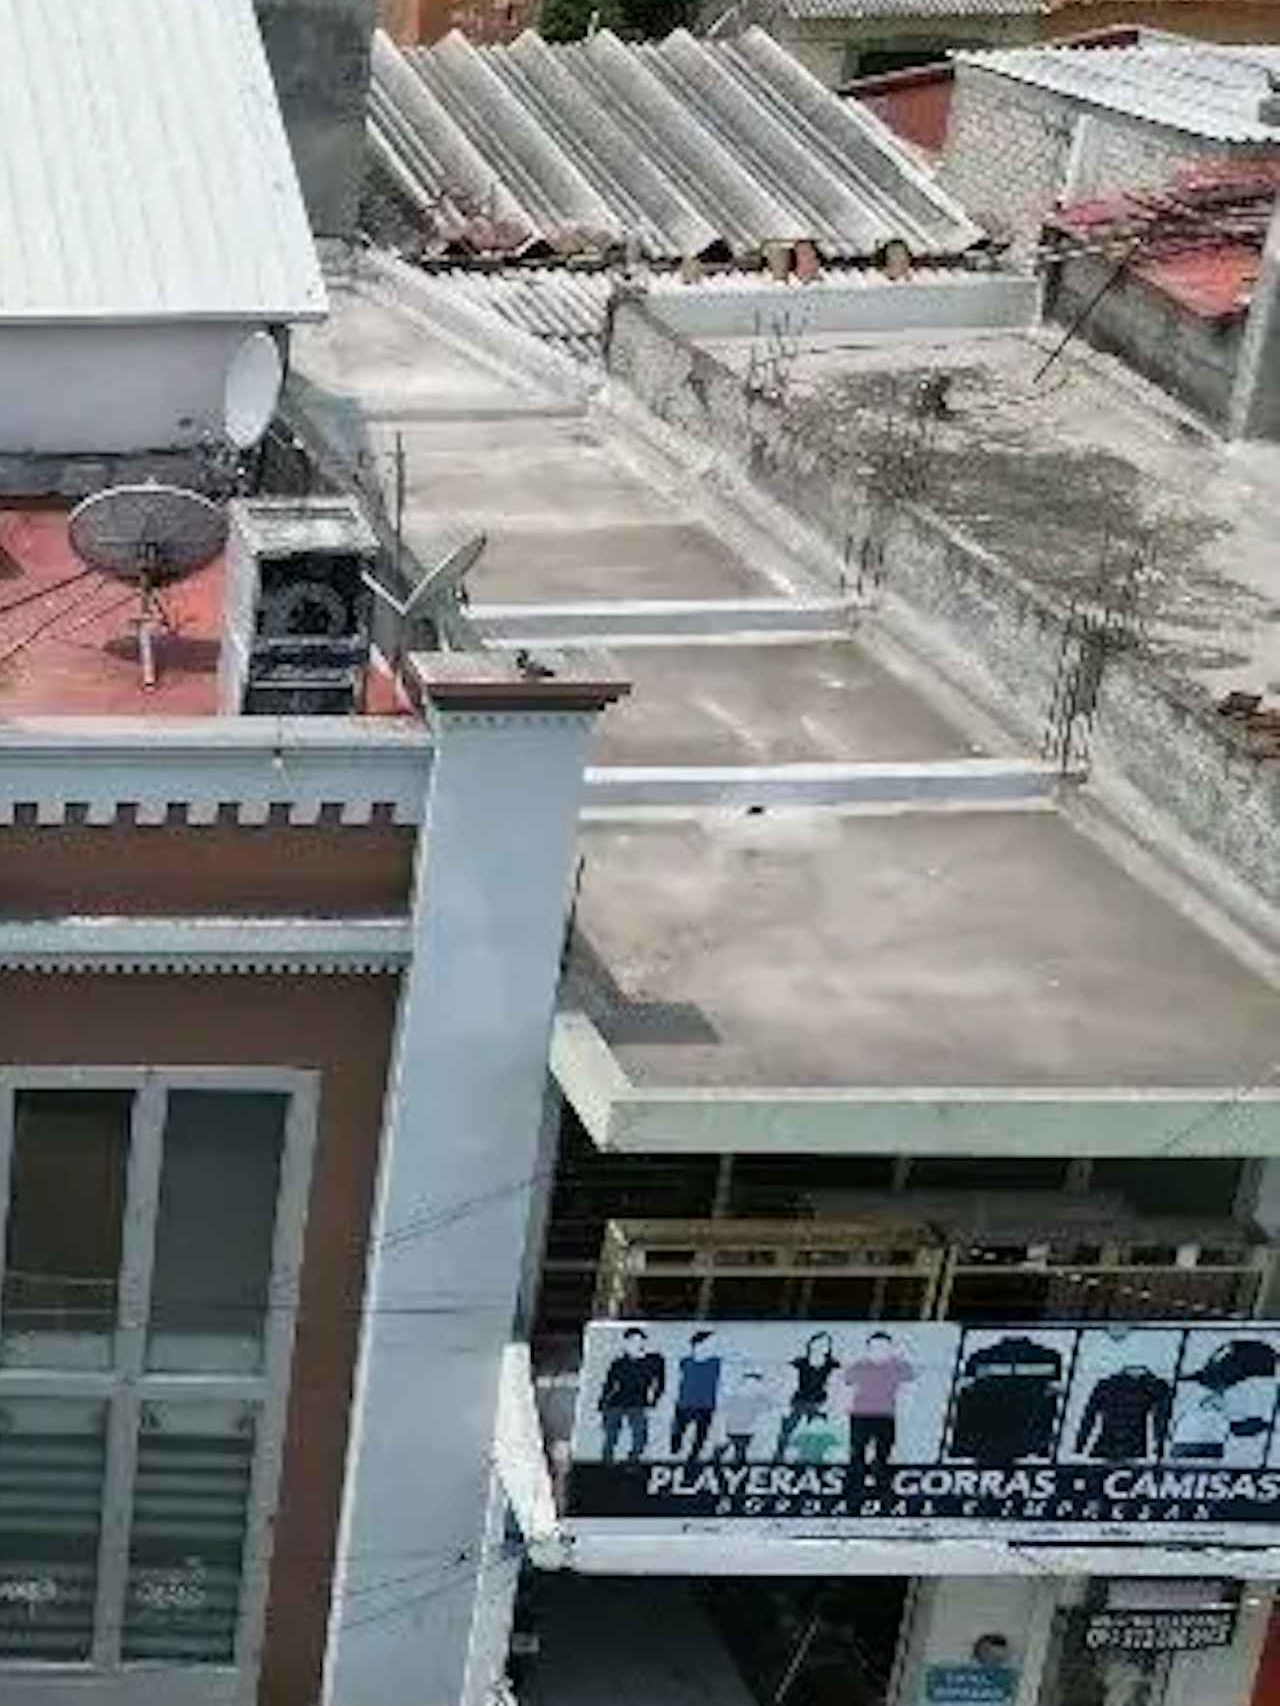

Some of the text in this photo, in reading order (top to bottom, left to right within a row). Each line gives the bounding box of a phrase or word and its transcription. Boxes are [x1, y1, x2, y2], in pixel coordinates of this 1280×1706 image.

[646, 1466, 1280, 1500] PLAYERAS GORRAS CAMISAS
